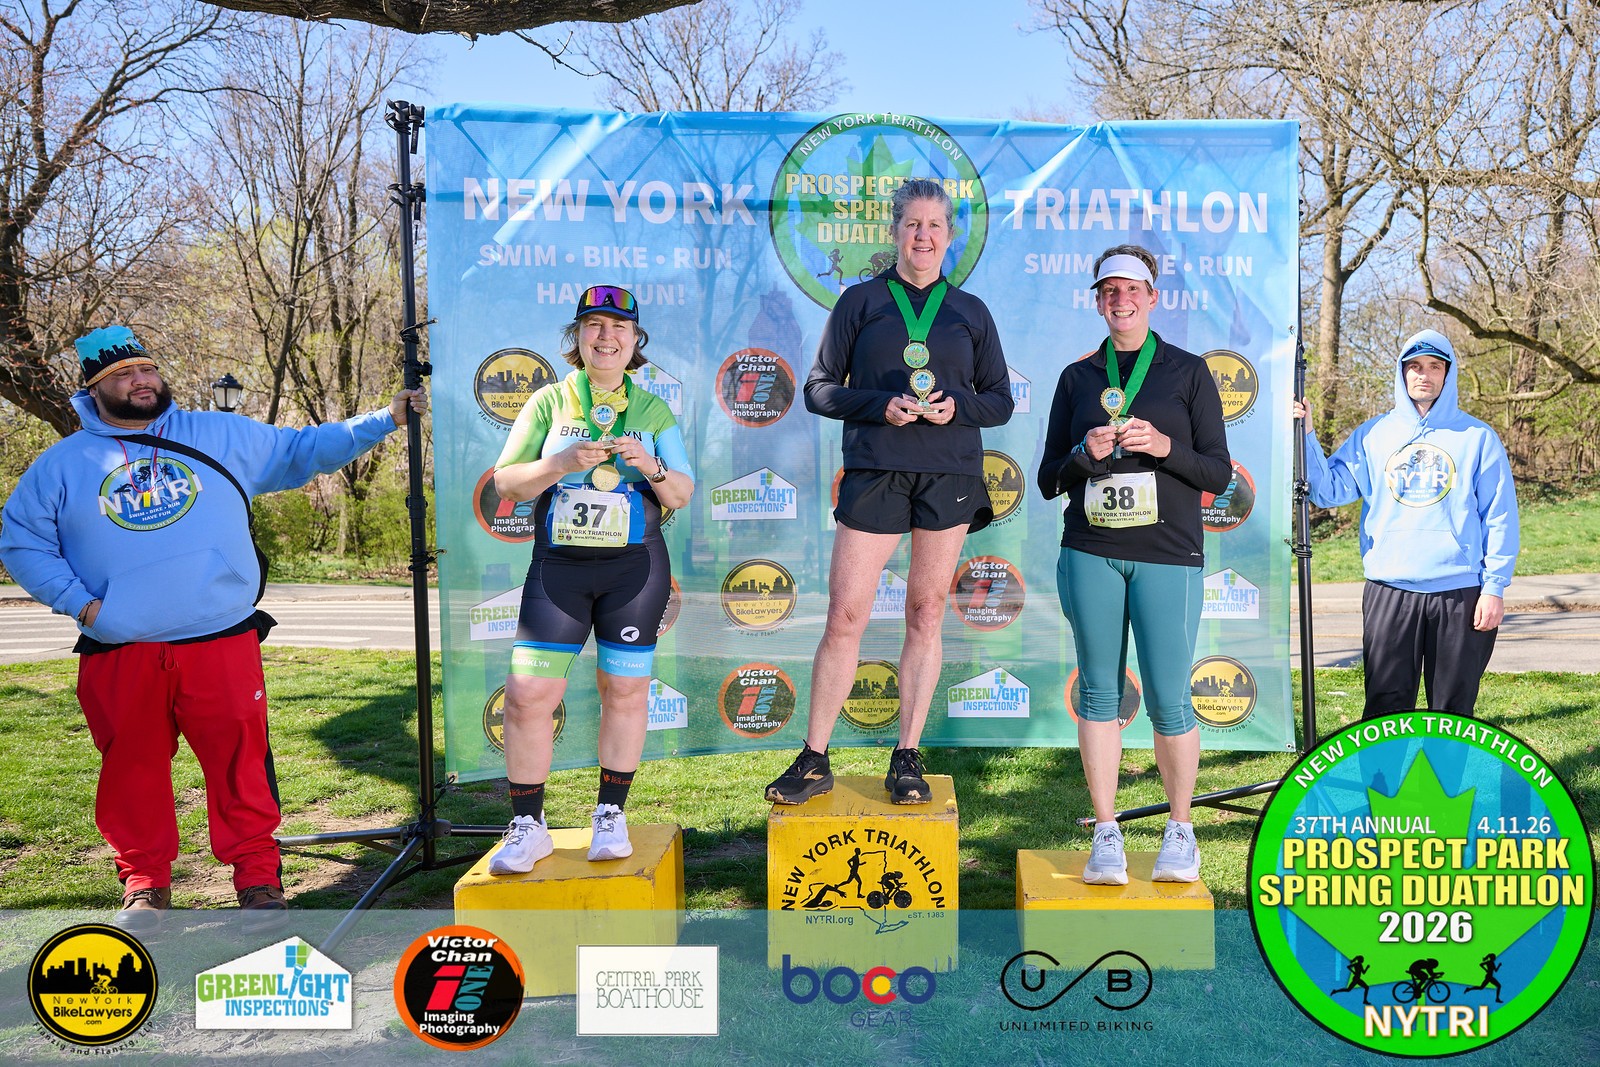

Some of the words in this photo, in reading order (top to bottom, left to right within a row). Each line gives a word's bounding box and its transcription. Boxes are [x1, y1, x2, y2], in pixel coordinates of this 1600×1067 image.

[800, 125, 832, 156] NEW
[833, 112, 877, 132] YORK
[880, 112, 963, 161] TRIATHLON
[463, 177, 590, 222] NEW
[602, 180, 757, 226] YORK
[833, 198, 894, 221] SPRI
[1004, 188, 1268, 233] TRIATHLON
[816, 222, 894, 244] DUATH
[479, 244, 557, 268] SWIM
[584, 245, 648, 268] BIKE
[674, 247, 732, 270] RUN
[1023, 253, 1093, 275] SWIM
[1203, 256, 1252, 278] RUN
[627, 283, 685, 306] UN!
[735, 354, 779, 363] Victor
[738, 363, 776, 371] Chan
[734, 402, 766, 410] Imaging
[731, 410, 781, 418] Photography
[712, 487, 795, 505] GREENLIGHT
[1103, 486, 1135, 510] 38
[728, 503, 785, 513] INSPECTIONS
[572, 502, 607, 529] 37
[1202, 516, 1241, 524] otography
[494, 516, 528, 525] Imaging
[491, 525, 535, 533] Photograp
[969, 561, 1010, 569] Victor
[971, 570, 1007, 578] Chan
[736, 607, 783, 615] BikeLawyers
[967, 607, 997, 615] Imaging
[965, 614, 1012, 622] Photography
[737, 669, 779, 677] Victor
[740, 678, 776, 686] Chan
[949, 686, 1028, 703] GREENLIGHT
[963, 701, 1018, 710] INSPECTIONS
[1197, 704, 1243, 712] BikeLawyers
[736, 714, 767, 722] Imaging
[733, 721, 782, 729] Photography
[781, 866, 805, 911] NEW
[802, 829, 857, 863] YORK
[864, 829, 946, 909] TRIATHLON
[805, 915, 854, 926] NYTRI.org
